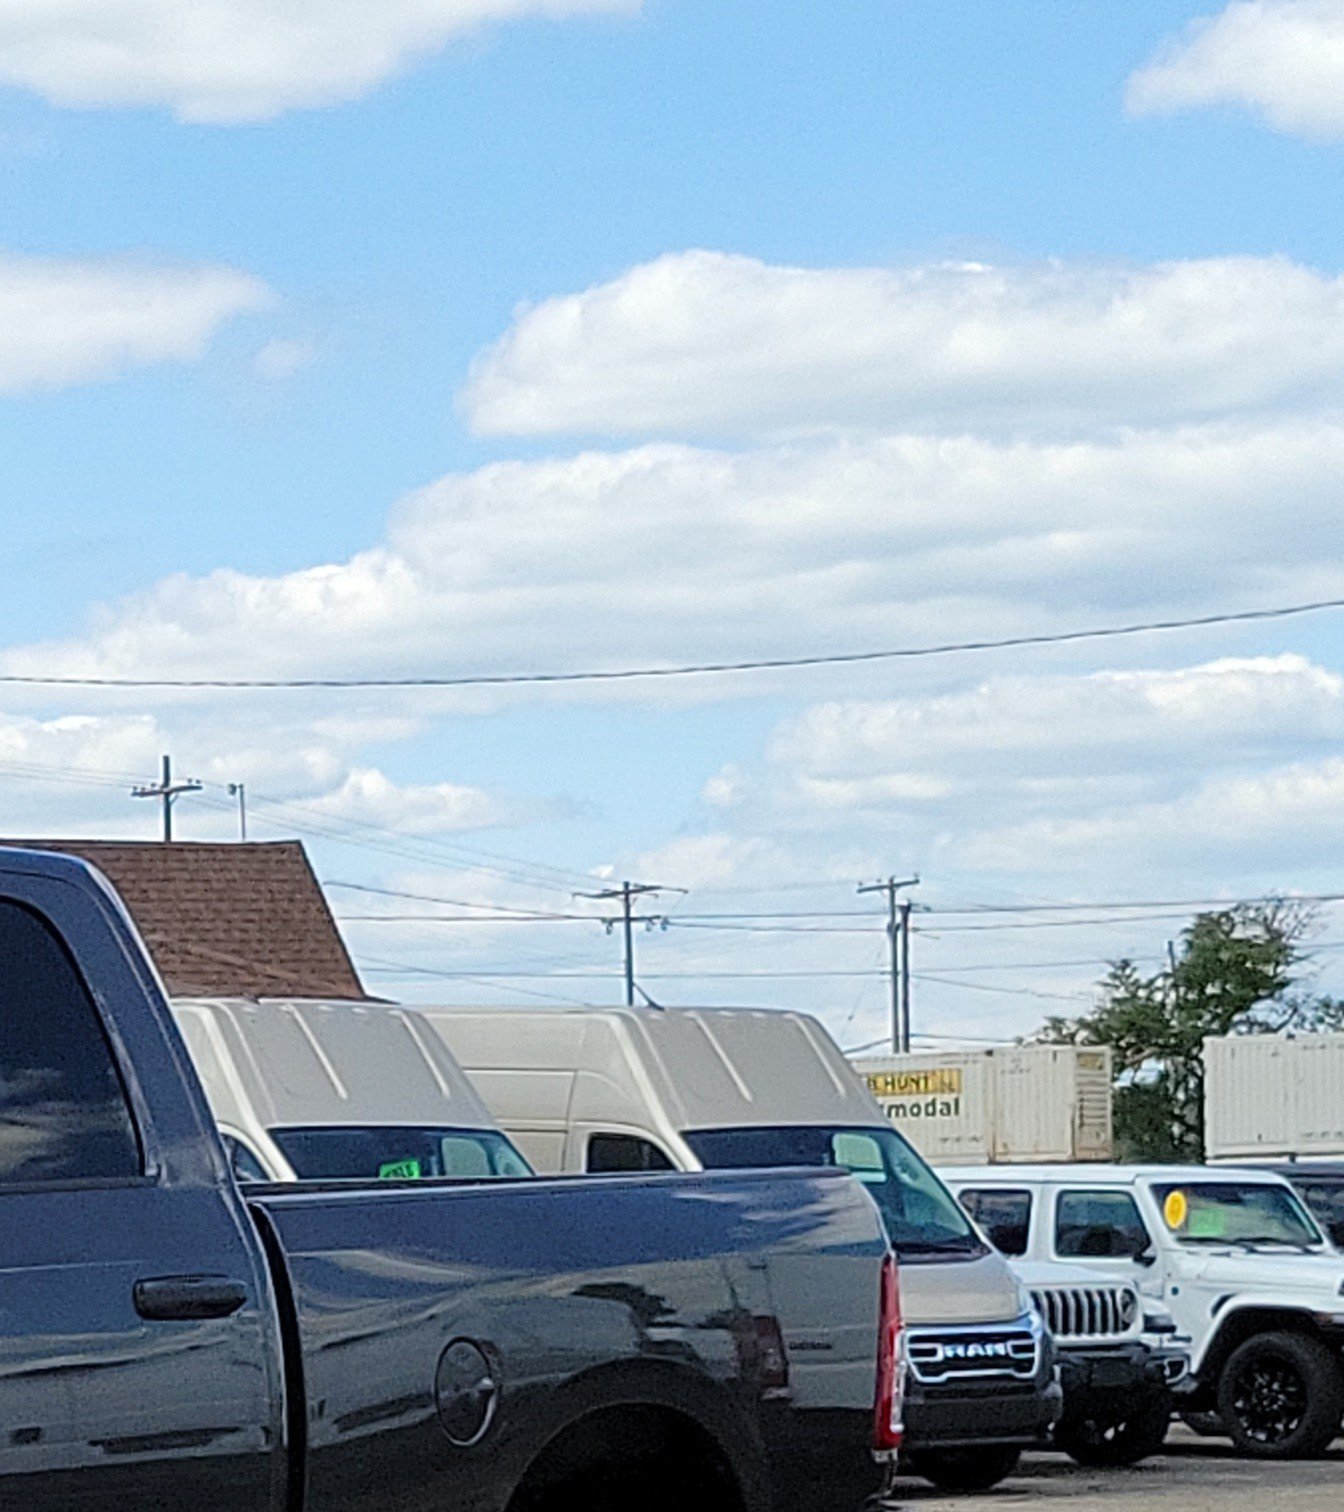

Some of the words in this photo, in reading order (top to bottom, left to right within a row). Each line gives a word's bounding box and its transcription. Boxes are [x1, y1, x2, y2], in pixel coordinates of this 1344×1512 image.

[884, 1074, 929, 1092] HUNT
[879, 1096, 960, 1118] modal
[944, 1342, 1007, 1358] RAM
